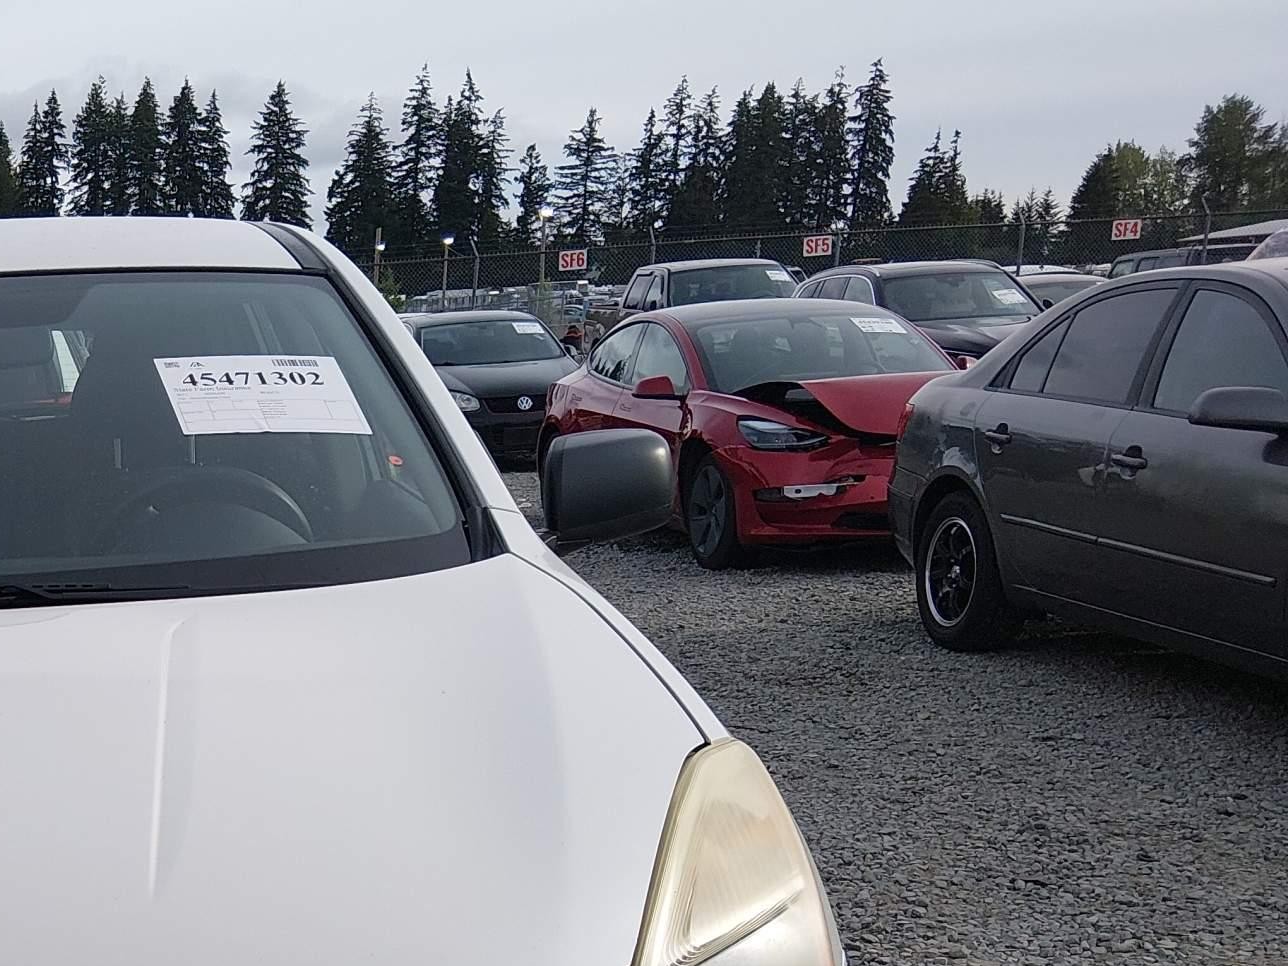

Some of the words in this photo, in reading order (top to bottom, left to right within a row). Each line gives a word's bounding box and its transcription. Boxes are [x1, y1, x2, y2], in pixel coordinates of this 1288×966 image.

[1114, 221, 1139, 238] SF4
[806, 237, 830, 254] SF5
[561, 252, 585, 268] SF6
[182, 371, 325, 387] 45471302
